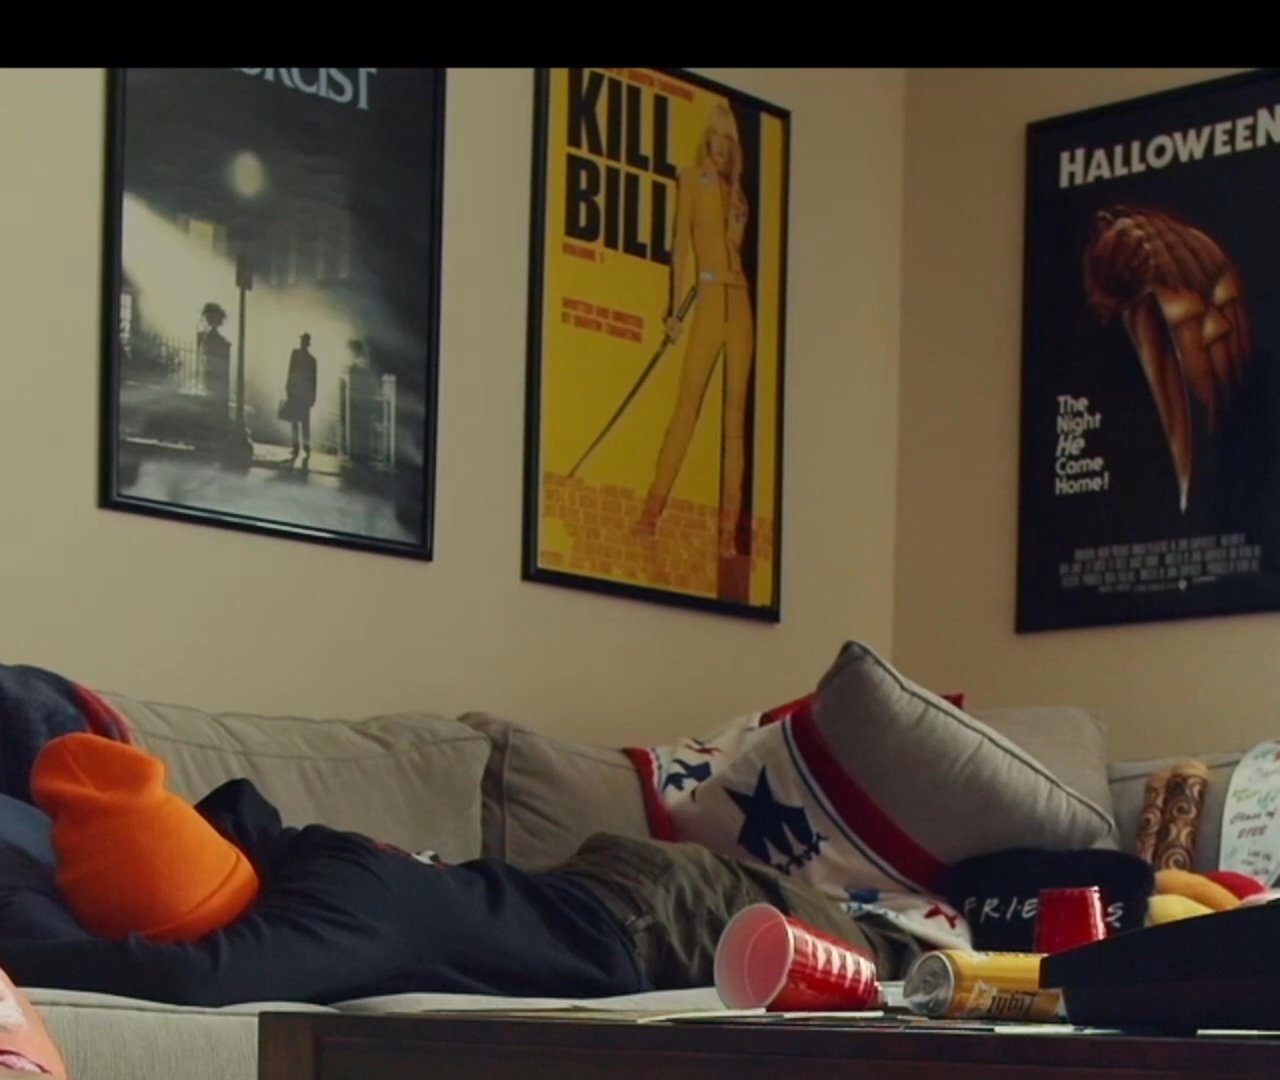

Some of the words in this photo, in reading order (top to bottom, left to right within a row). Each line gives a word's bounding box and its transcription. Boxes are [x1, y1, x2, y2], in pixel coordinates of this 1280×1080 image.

[567, 68, 678, 180] KILL
[564, 153, 673, 266] BILL
[1057, 395, 1088, 414] The
[1057, 411, 1102, 436] Night
[1056, 433, 1085, 457] He
[1056, 456, 1104, 476] Came
[1055, 471, 1109, 496] Home!
[964, 896, 1123, 928] FRIES
